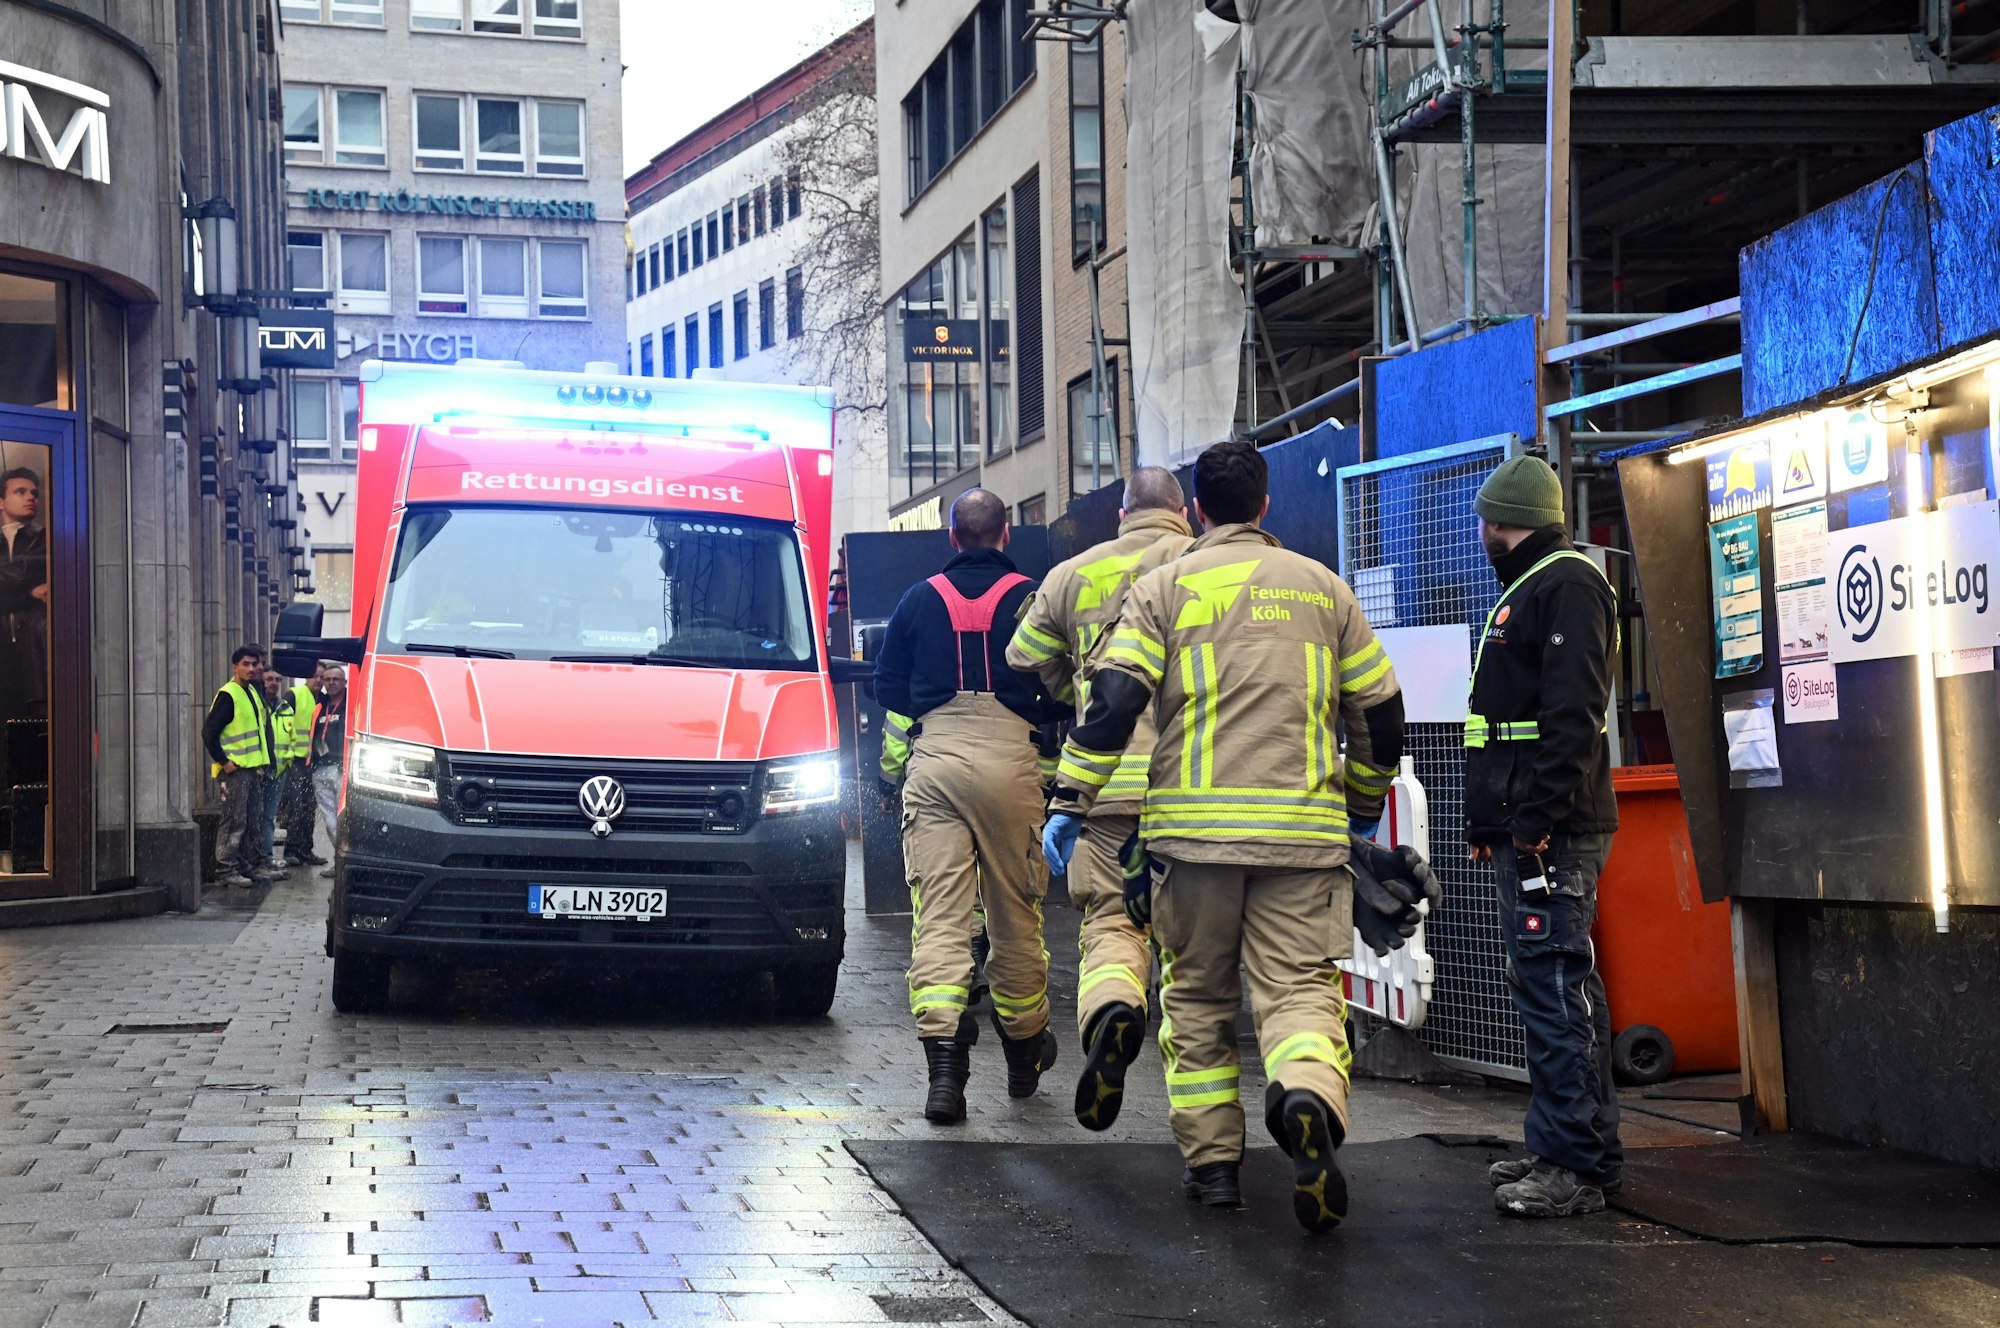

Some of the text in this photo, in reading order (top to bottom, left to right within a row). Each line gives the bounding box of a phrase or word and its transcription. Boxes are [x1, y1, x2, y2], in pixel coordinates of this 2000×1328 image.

[1406, 77, 1420, 103] Ali
[306, 187, 597, 222] ECHT KÖLNISCH WASSER
[258, 326, 326, 350] TUMI
[377, 330, 478, 361] HYGH
[912, 346, 974, 355] VICTORINOX
[461, 471, 744, 503] Rettungsdienst
[1709, 472, 1725, 492] alle
[1890, 560, 1989, 615] SieLog
[1251, 605, 1291, 621] Köln
[1803, 678, 1835, 698] SiteLog
[1803, 699, 1830, 709] Baulogistik
[542, 889, 557, 911] K
[572, 890, 603, 912] LN
[607, 891, 663, 914] 3902
